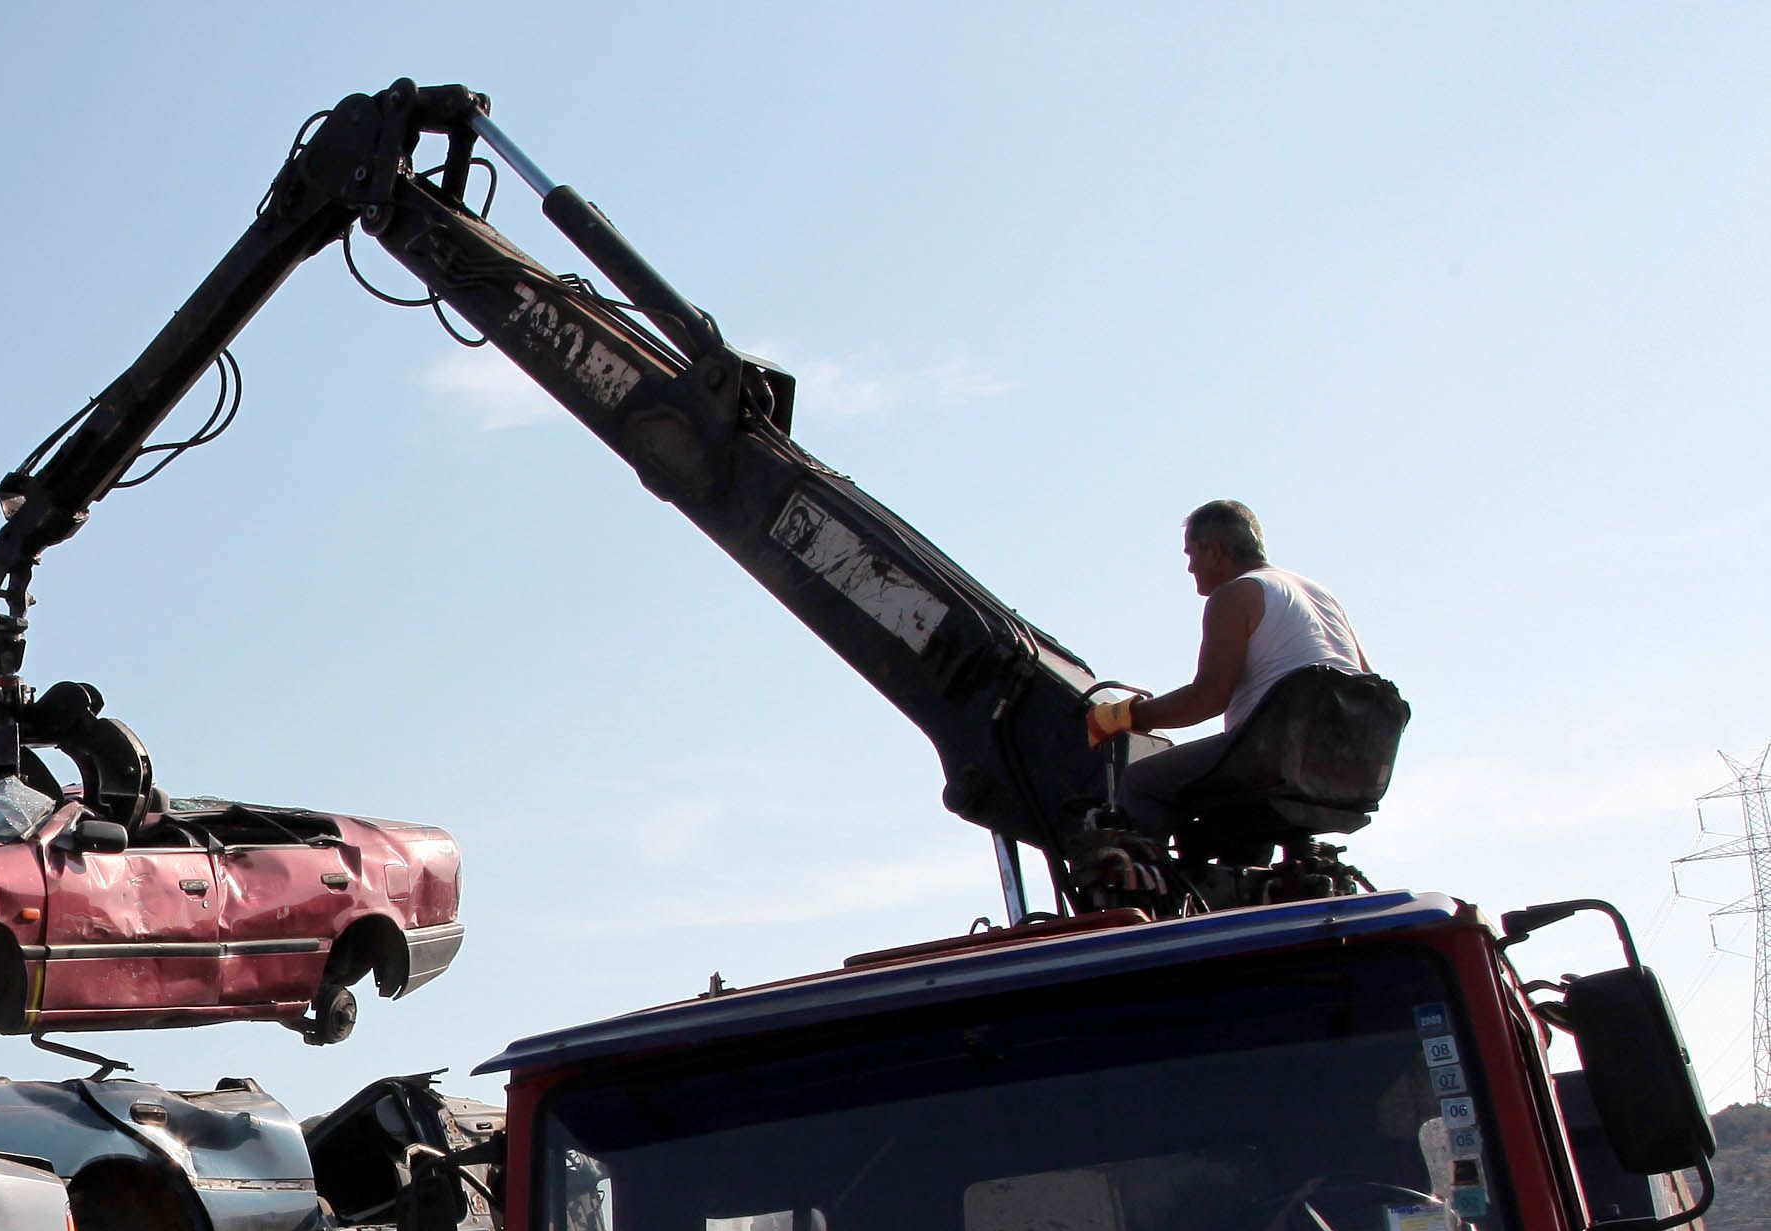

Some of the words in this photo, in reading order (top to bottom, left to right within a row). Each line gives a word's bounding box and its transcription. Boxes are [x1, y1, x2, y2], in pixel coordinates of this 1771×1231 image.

[1431, 1043, 1449, 1057] 08
[1438, 1073, 1456, 1087] 07
[1449, 1104, 1467, 1117] 06
[1456, 1133, 1474, 1147] 05
